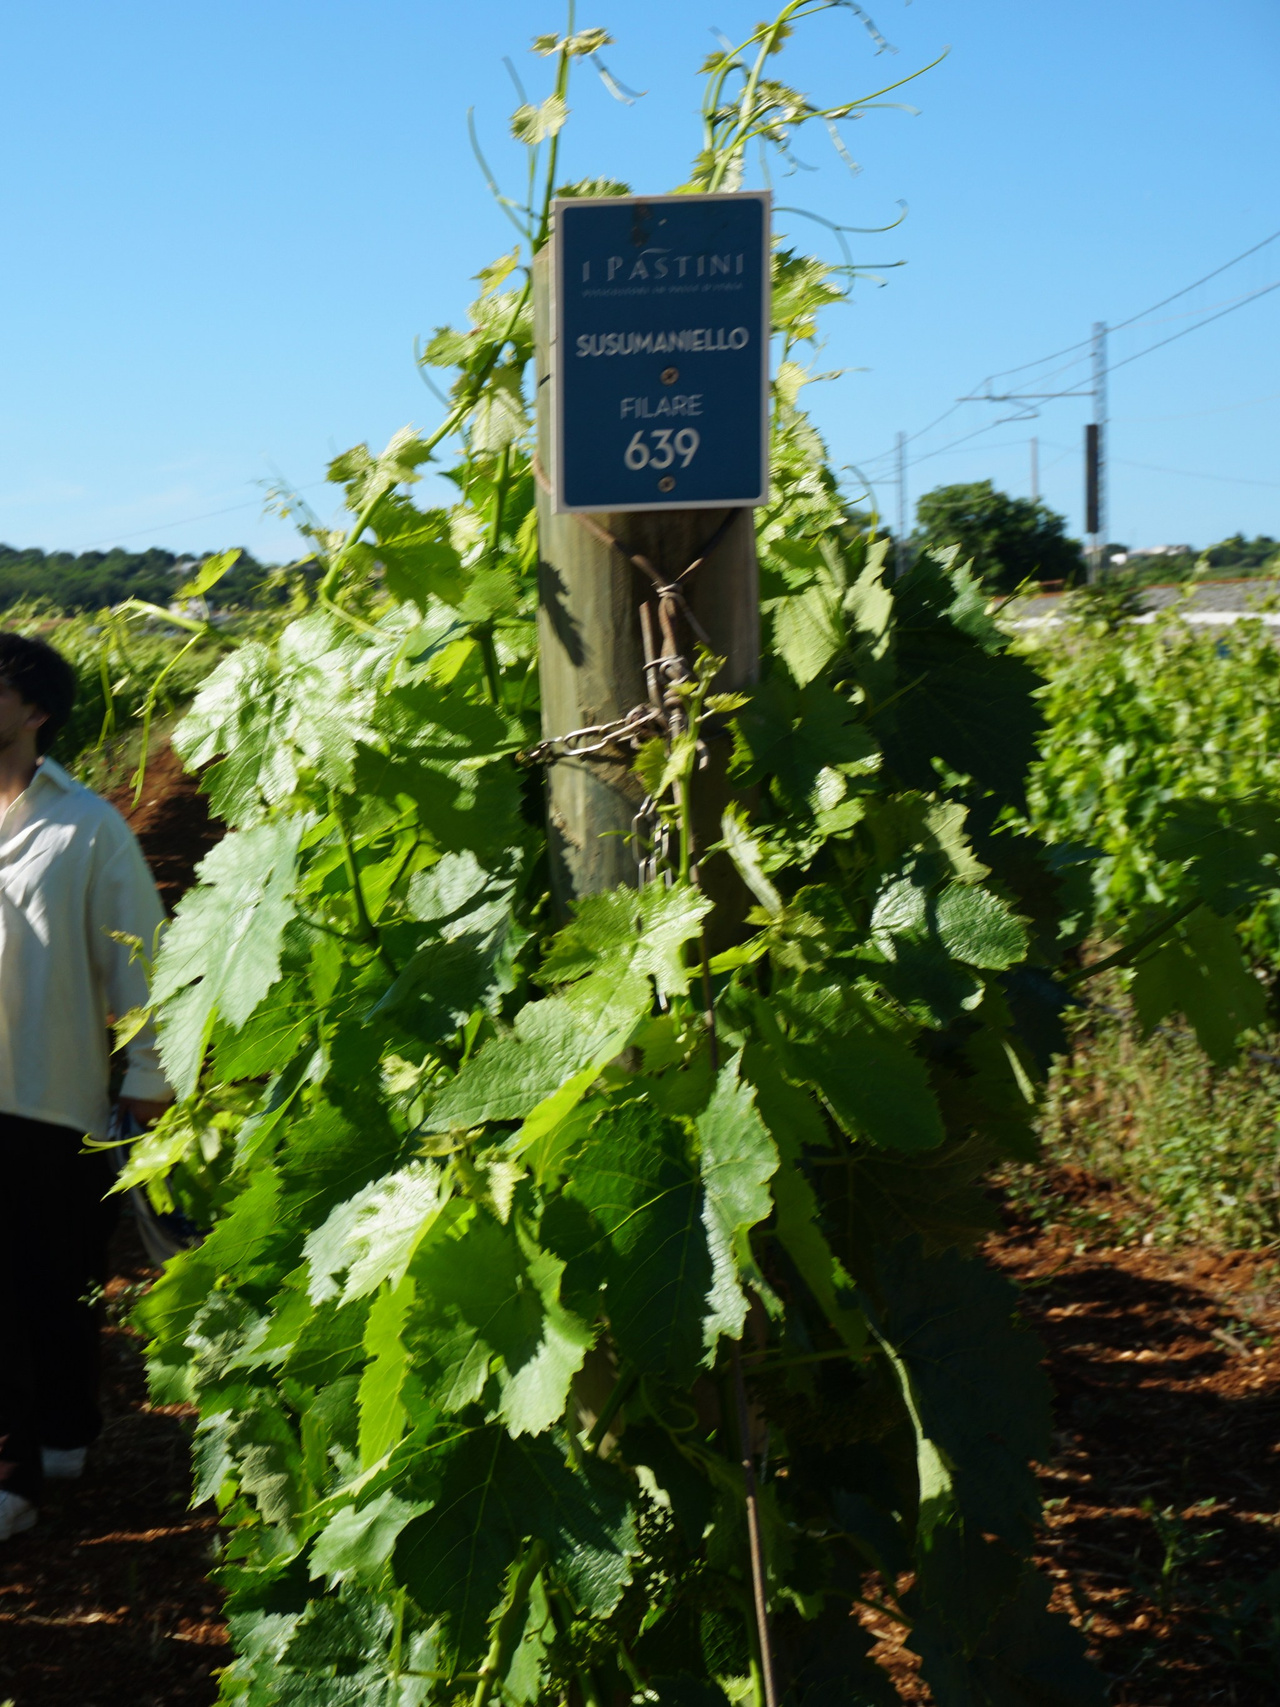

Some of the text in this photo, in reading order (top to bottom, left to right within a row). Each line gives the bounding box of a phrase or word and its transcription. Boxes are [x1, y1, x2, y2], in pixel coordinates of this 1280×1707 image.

[582, 260, 590, 283] I
[576, 327, 749, 357] SUSUMANIELLO
[620, 394, 704, 419] FILARE
[624, 428, 700, 471] 639
